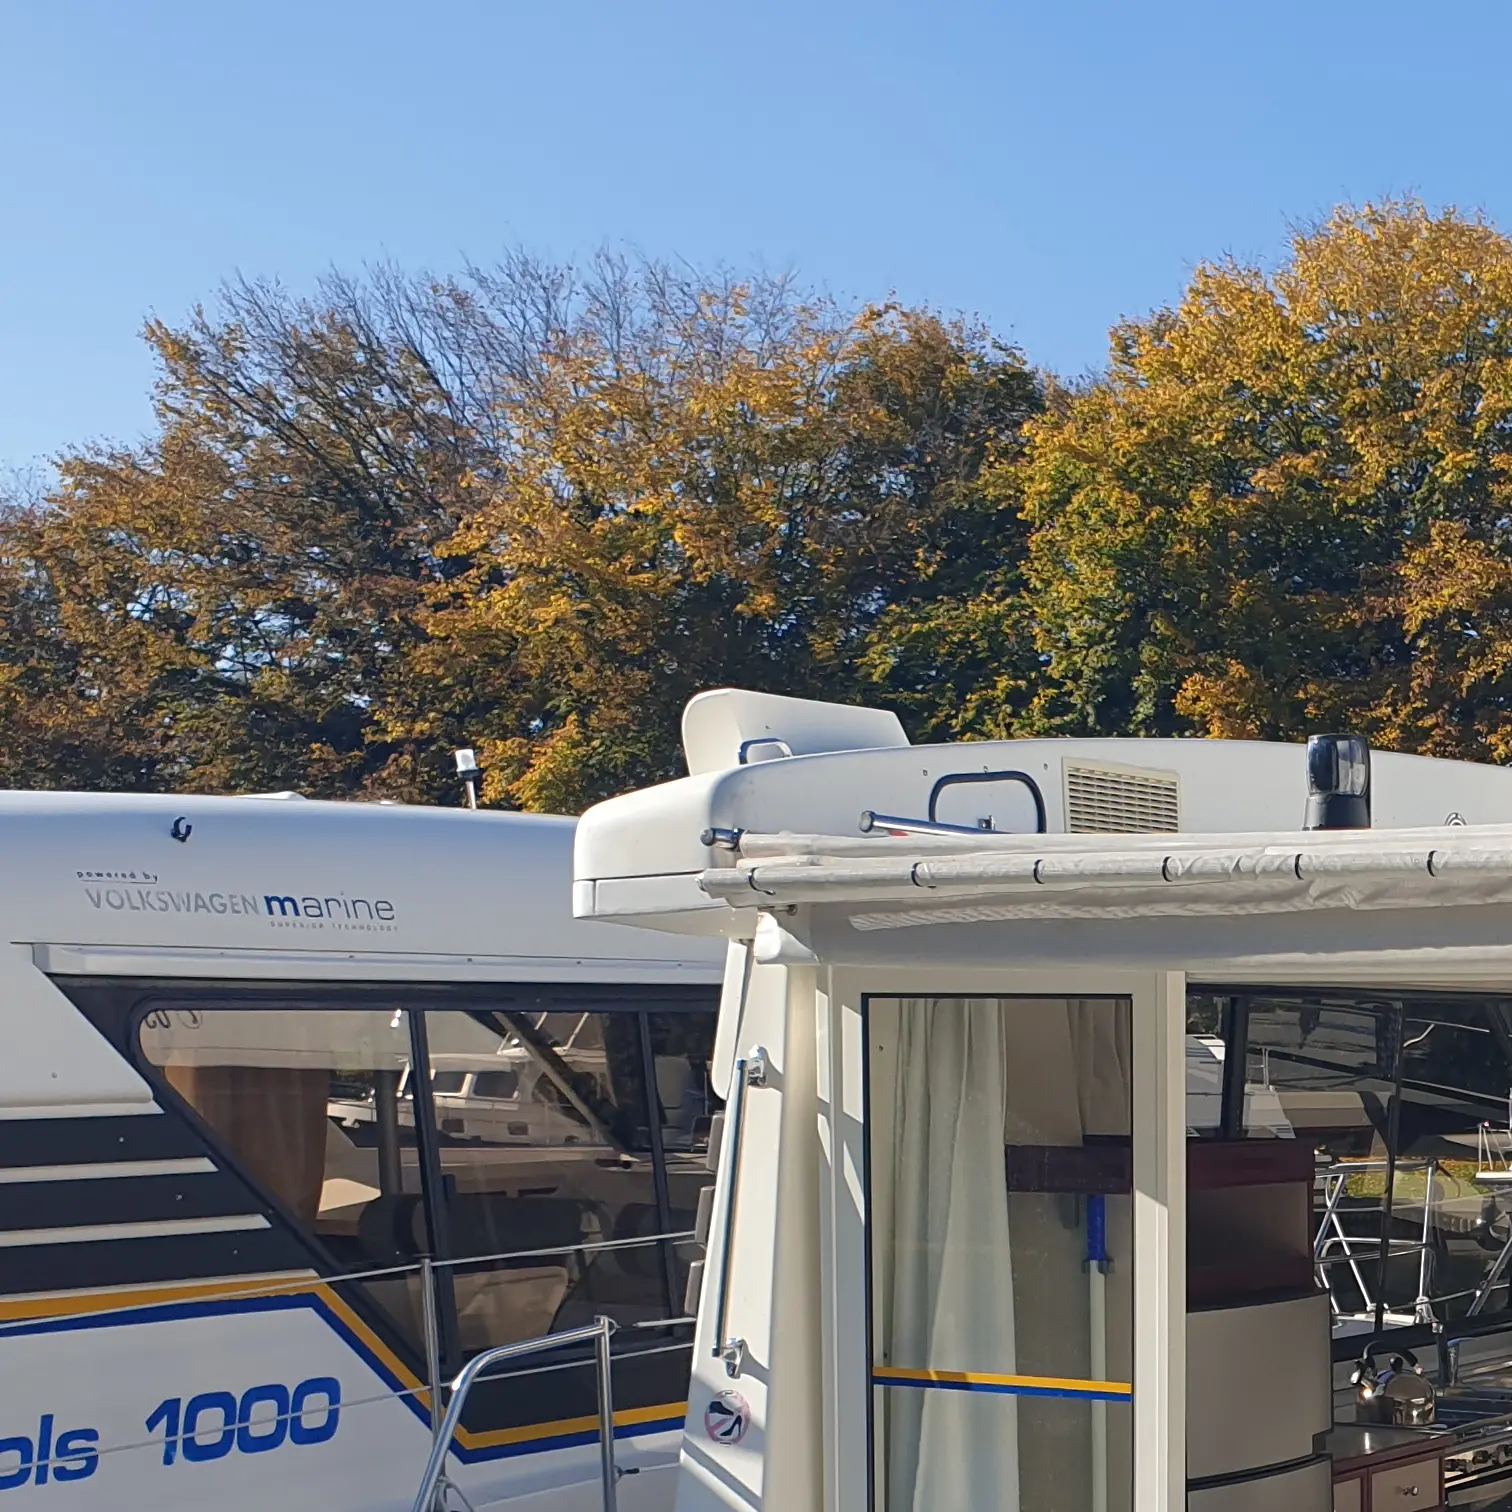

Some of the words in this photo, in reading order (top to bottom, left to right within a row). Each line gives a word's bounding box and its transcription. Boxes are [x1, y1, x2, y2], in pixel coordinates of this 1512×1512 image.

[77, 870, 137, 881] powered
[143, 871, 159, 883] by
[84, 887, 260, 916] VOLKSWAGEN
[263, 891, 396, 921] marine
[0, 1413, 99, 1491] ols
[145, 1376, 341, 1467] 1000
